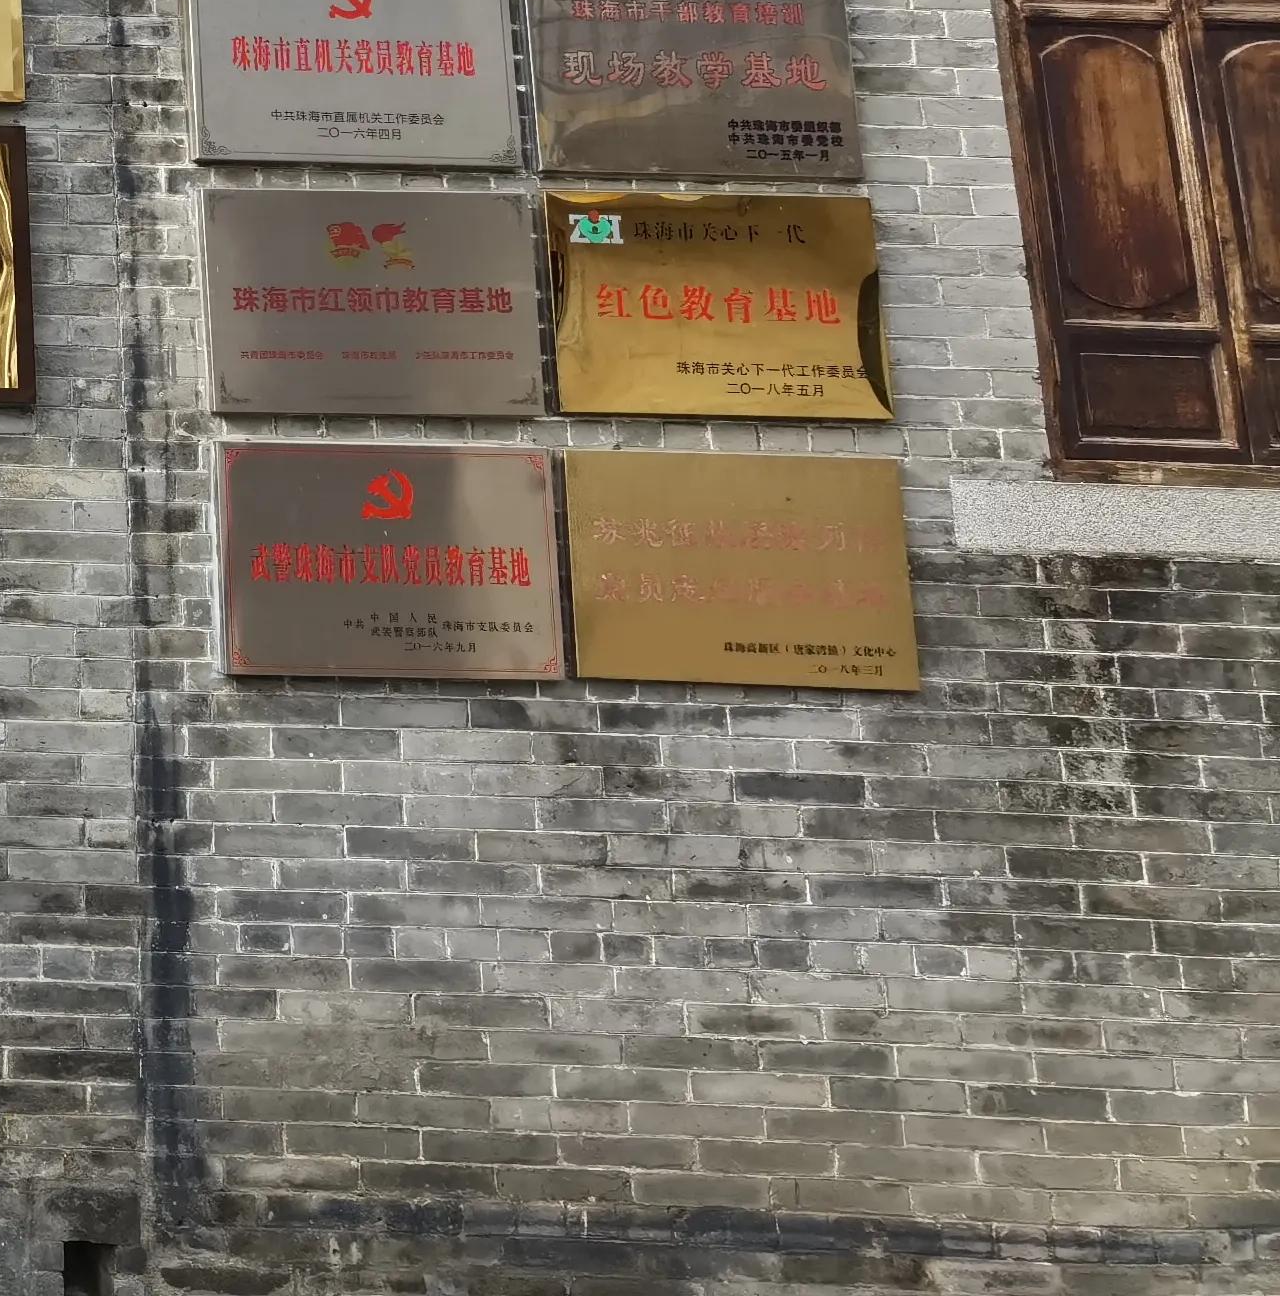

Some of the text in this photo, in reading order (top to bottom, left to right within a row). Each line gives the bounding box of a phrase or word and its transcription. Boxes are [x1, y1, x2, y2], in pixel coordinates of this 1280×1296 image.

[571, 0, 805, 26] 珠海市干部教育培训
[230, 34, 476, 79] 珠海市直机关党员教育基地
[562, 50, 828, 92] 现场教学基地
[270, 110, 445, 126] 中共珠海市直属机关工作委员会
[232, 286, 513, 314] 珠海市红领巾教育基地
[596, 283, 842, 325] 红色教育基地
[675, 361, 869, 380] 珠海市关心下一代工作委员会
[249, 542, 532, 587] 武警珠海市支队党员教育基地
